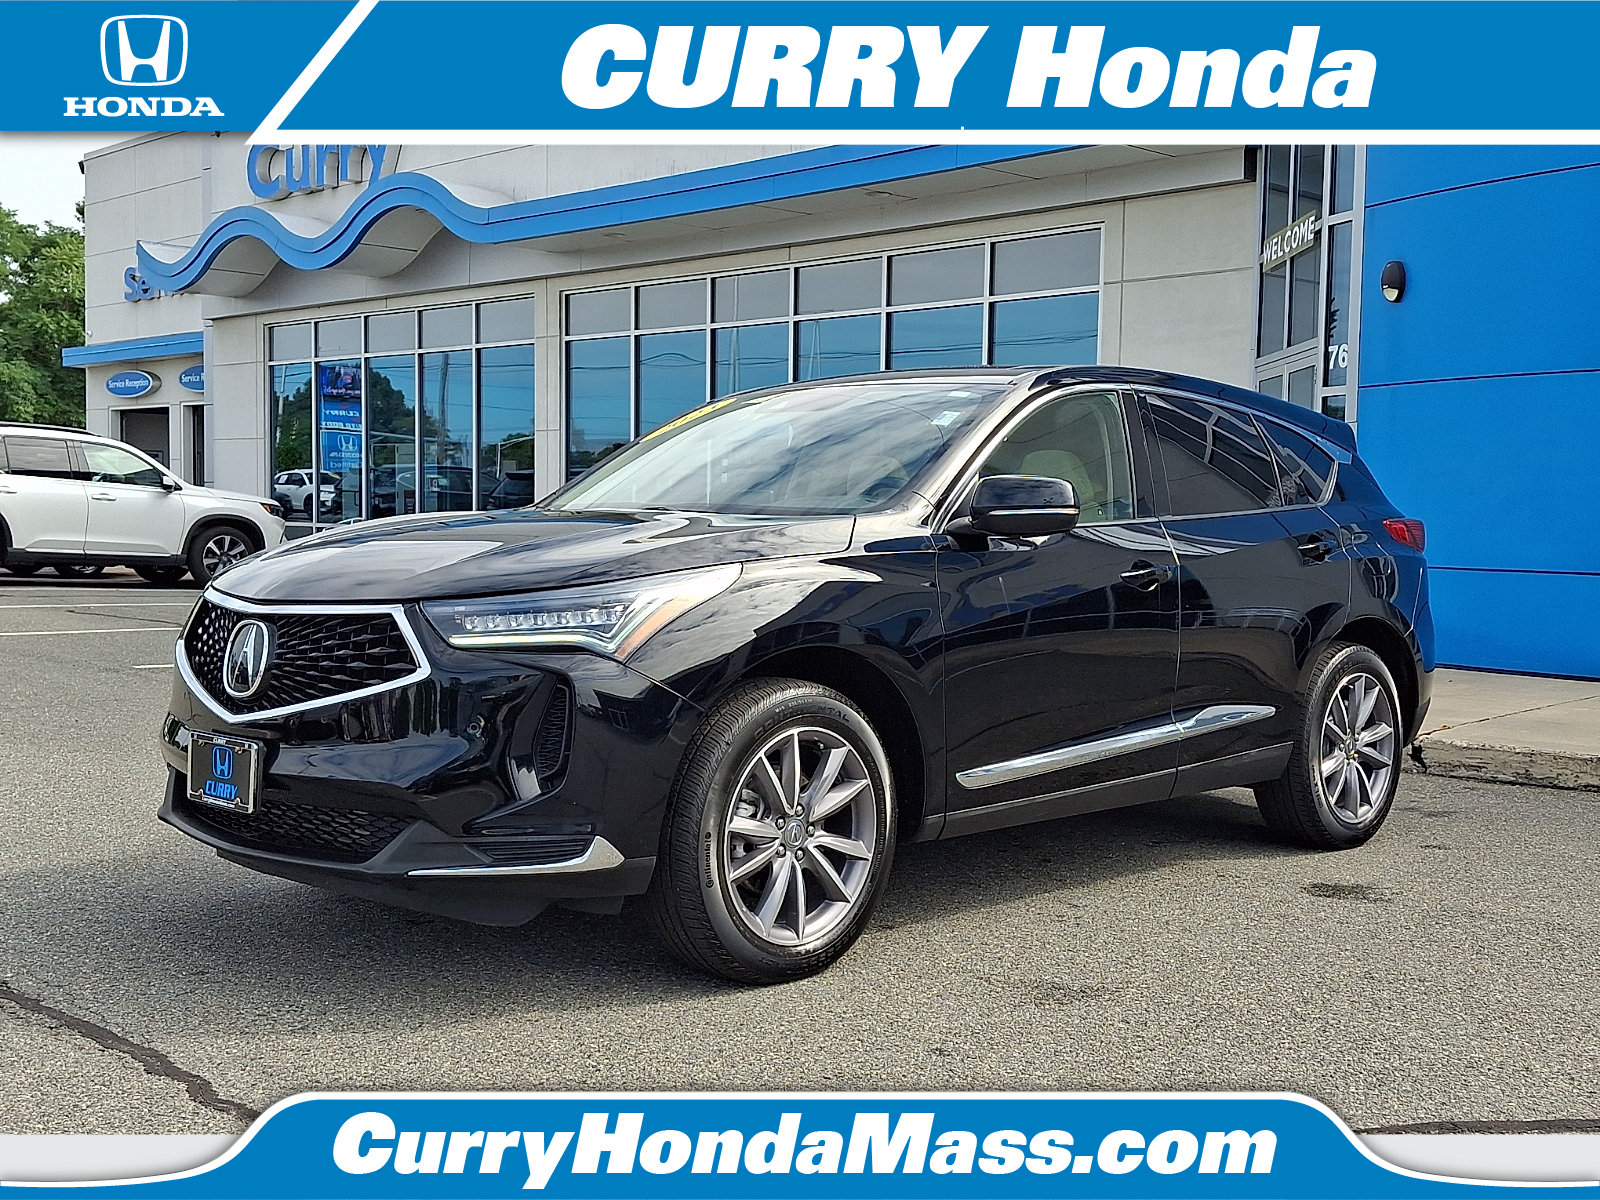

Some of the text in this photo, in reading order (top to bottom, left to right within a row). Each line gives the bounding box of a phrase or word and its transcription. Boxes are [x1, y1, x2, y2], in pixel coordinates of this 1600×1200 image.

[1263, 215, 1316, 265] WELCOME
[1328, 343, 1349, 369] 76
[108, 378, 149, 389] Service Reception
[181, 373, 200, 383] Service
[205, 780, 239, 800] CURRY
